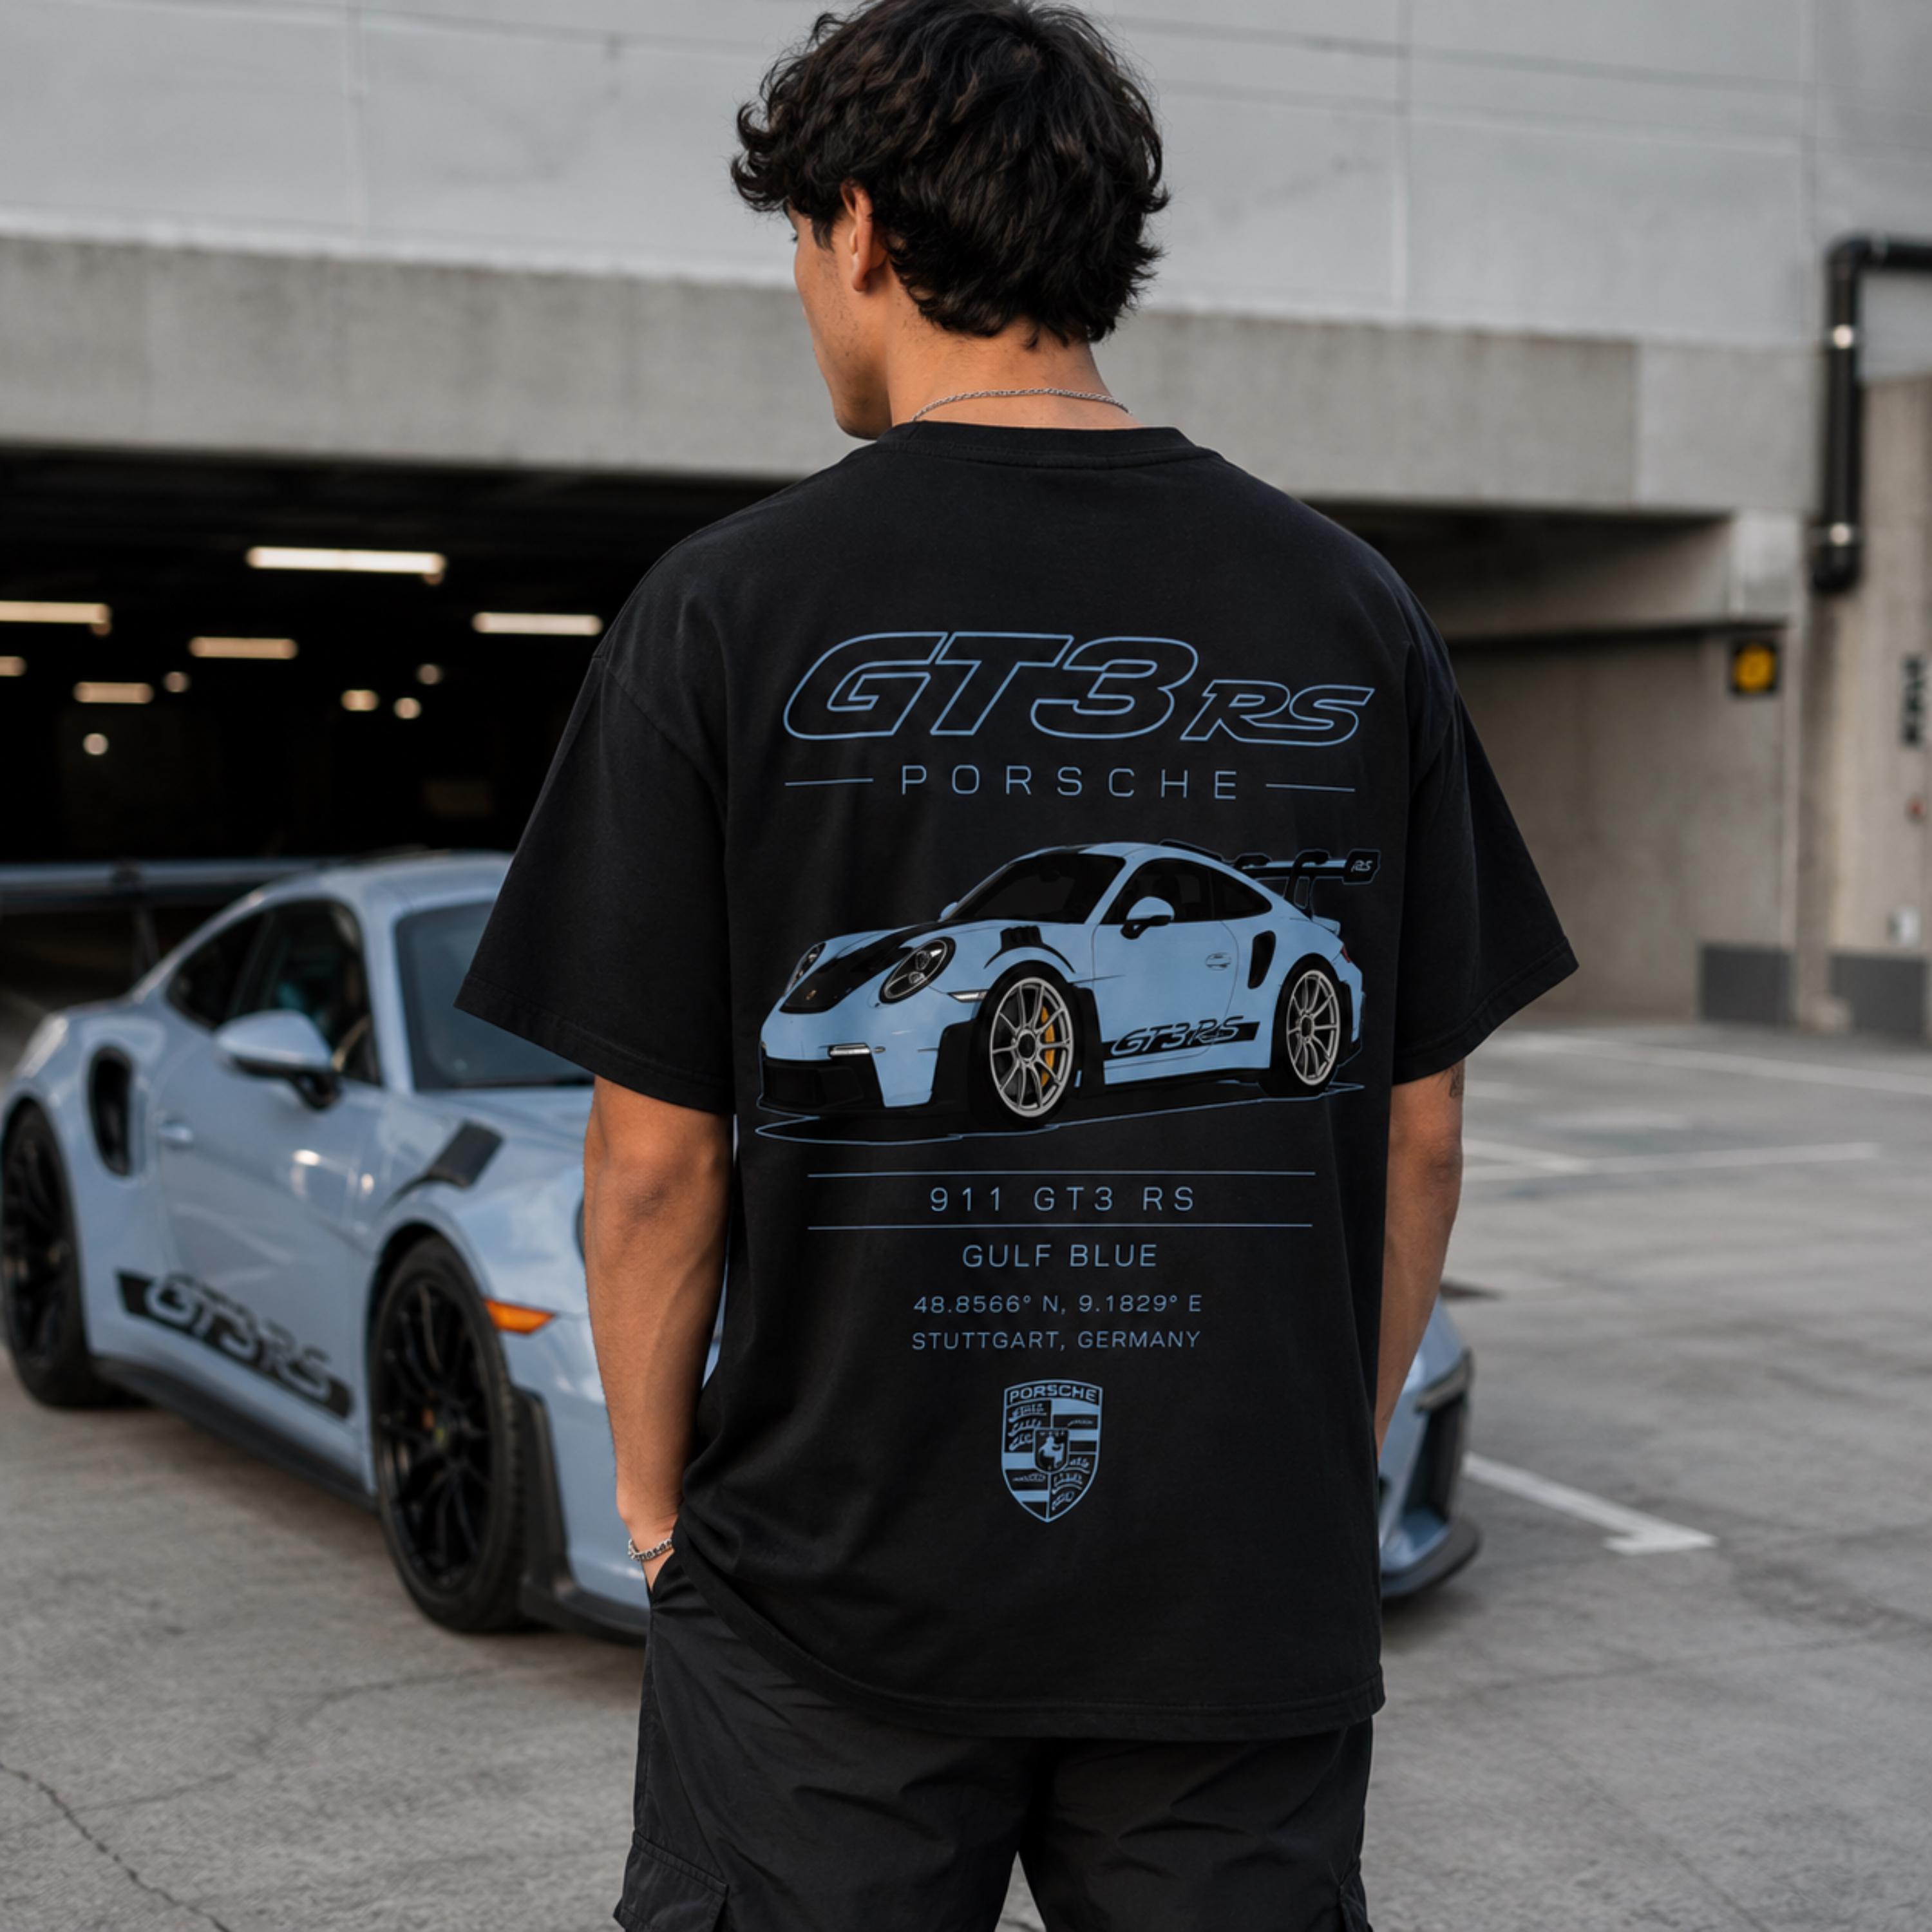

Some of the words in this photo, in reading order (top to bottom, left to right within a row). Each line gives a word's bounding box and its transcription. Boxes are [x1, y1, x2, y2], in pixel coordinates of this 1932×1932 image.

[902, 764, 1236, 800] PORSCHE
[930, 1187, 999, 1212] 911
[1034, 1186, 1113, 1211] GT3
[1143, 1186, 1194, 1211] RS
[963, 1244, 1052, 1267] GULF
[1070, 1244, 1157, 1267] BLUE
[913, 1295, 1031, 1314] 48.8566°
[1043, 1295, 1066, 1315] N,
[1079, 1294, 1177, 1312] 9.1829°
[1189, 1294, 1202, 1312] E
[912, 1331, 1065, 1351] STUTTGART,
[1077, 1330, 1200, 1349] GERMANY
[1010, 1385, 1096, 1402] PORSCHE
